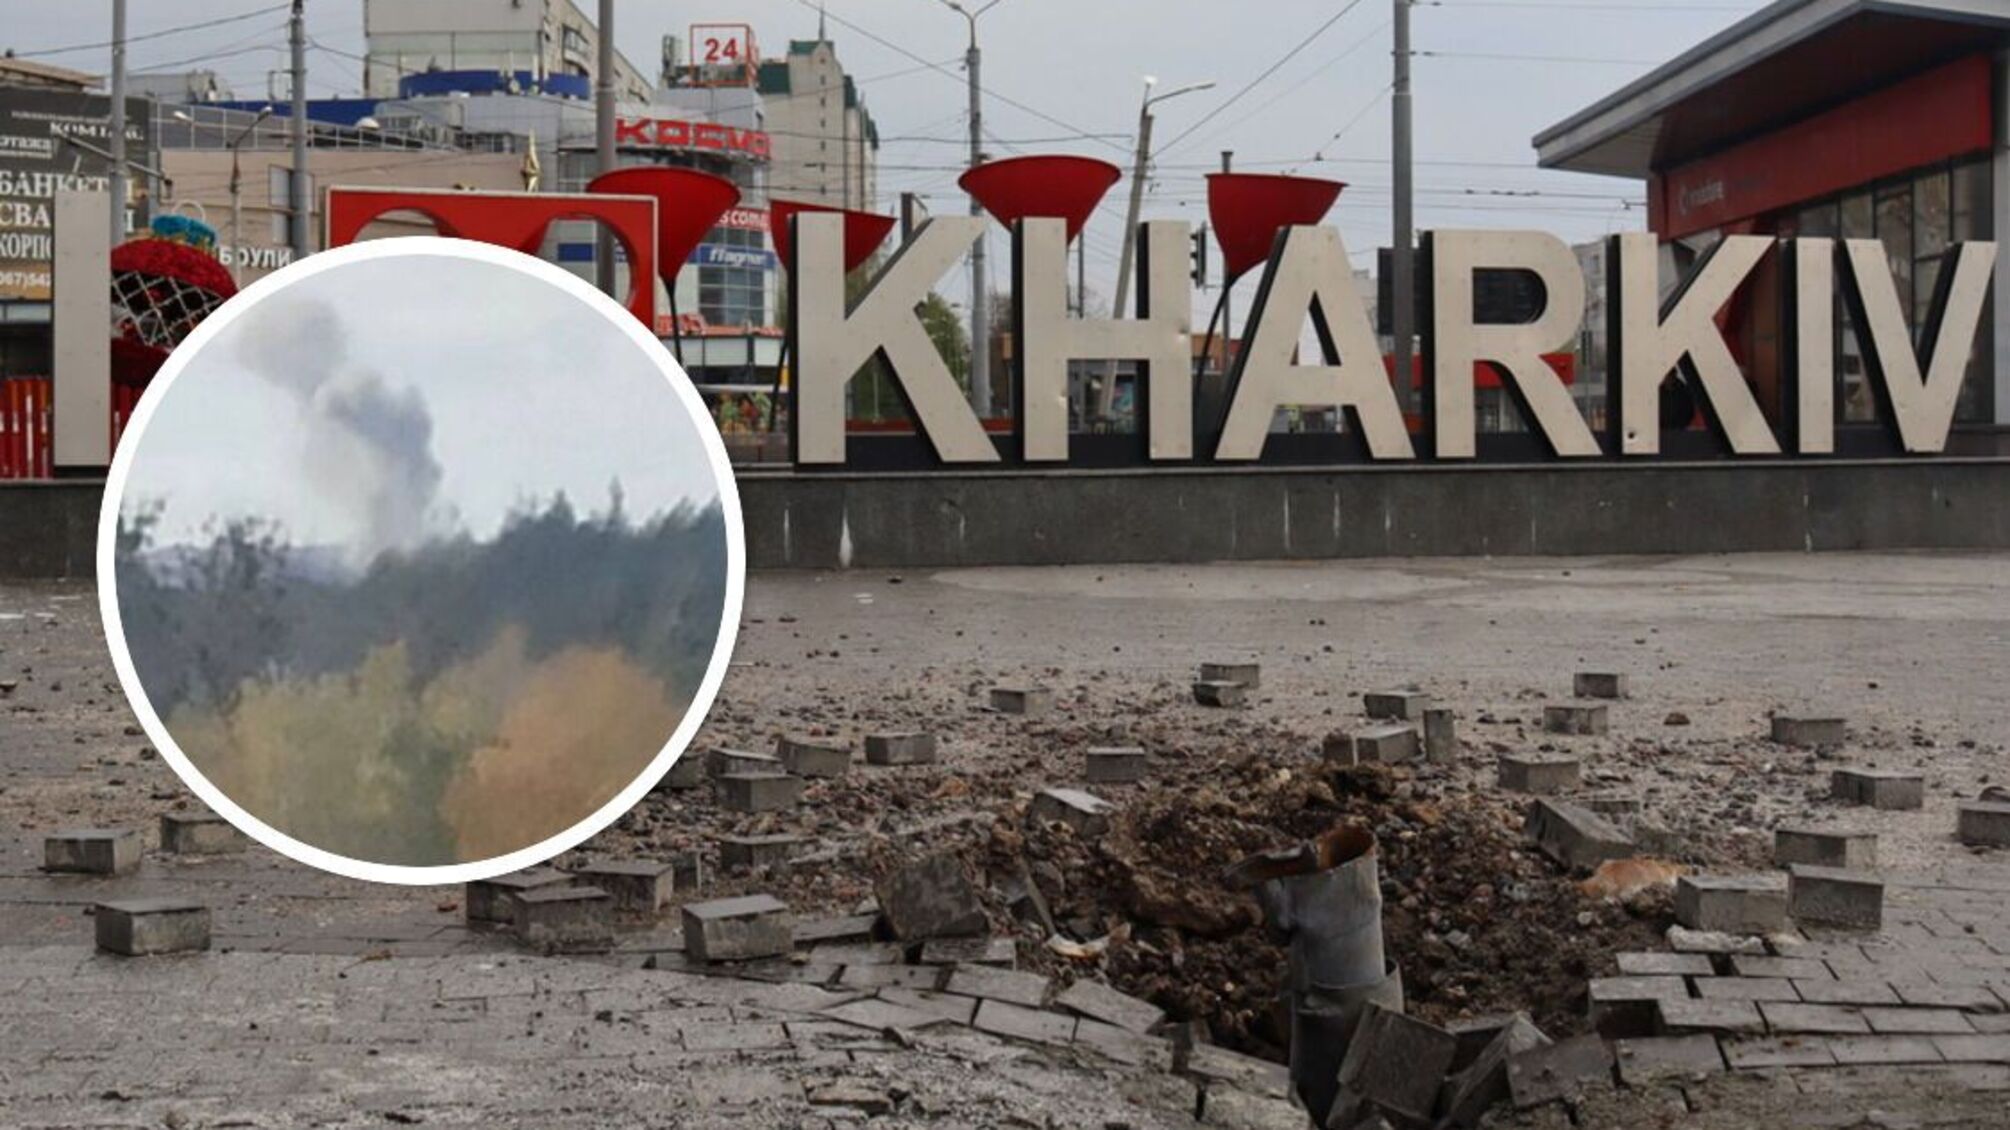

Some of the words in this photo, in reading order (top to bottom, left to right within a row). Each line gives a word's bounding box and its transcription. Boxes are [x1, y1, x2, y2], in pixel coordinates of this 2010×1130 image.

[704, 37, 739, 62] 24
[53, 191, 110, 466] I
[796, 211, 1997, 465] KHARKIV
